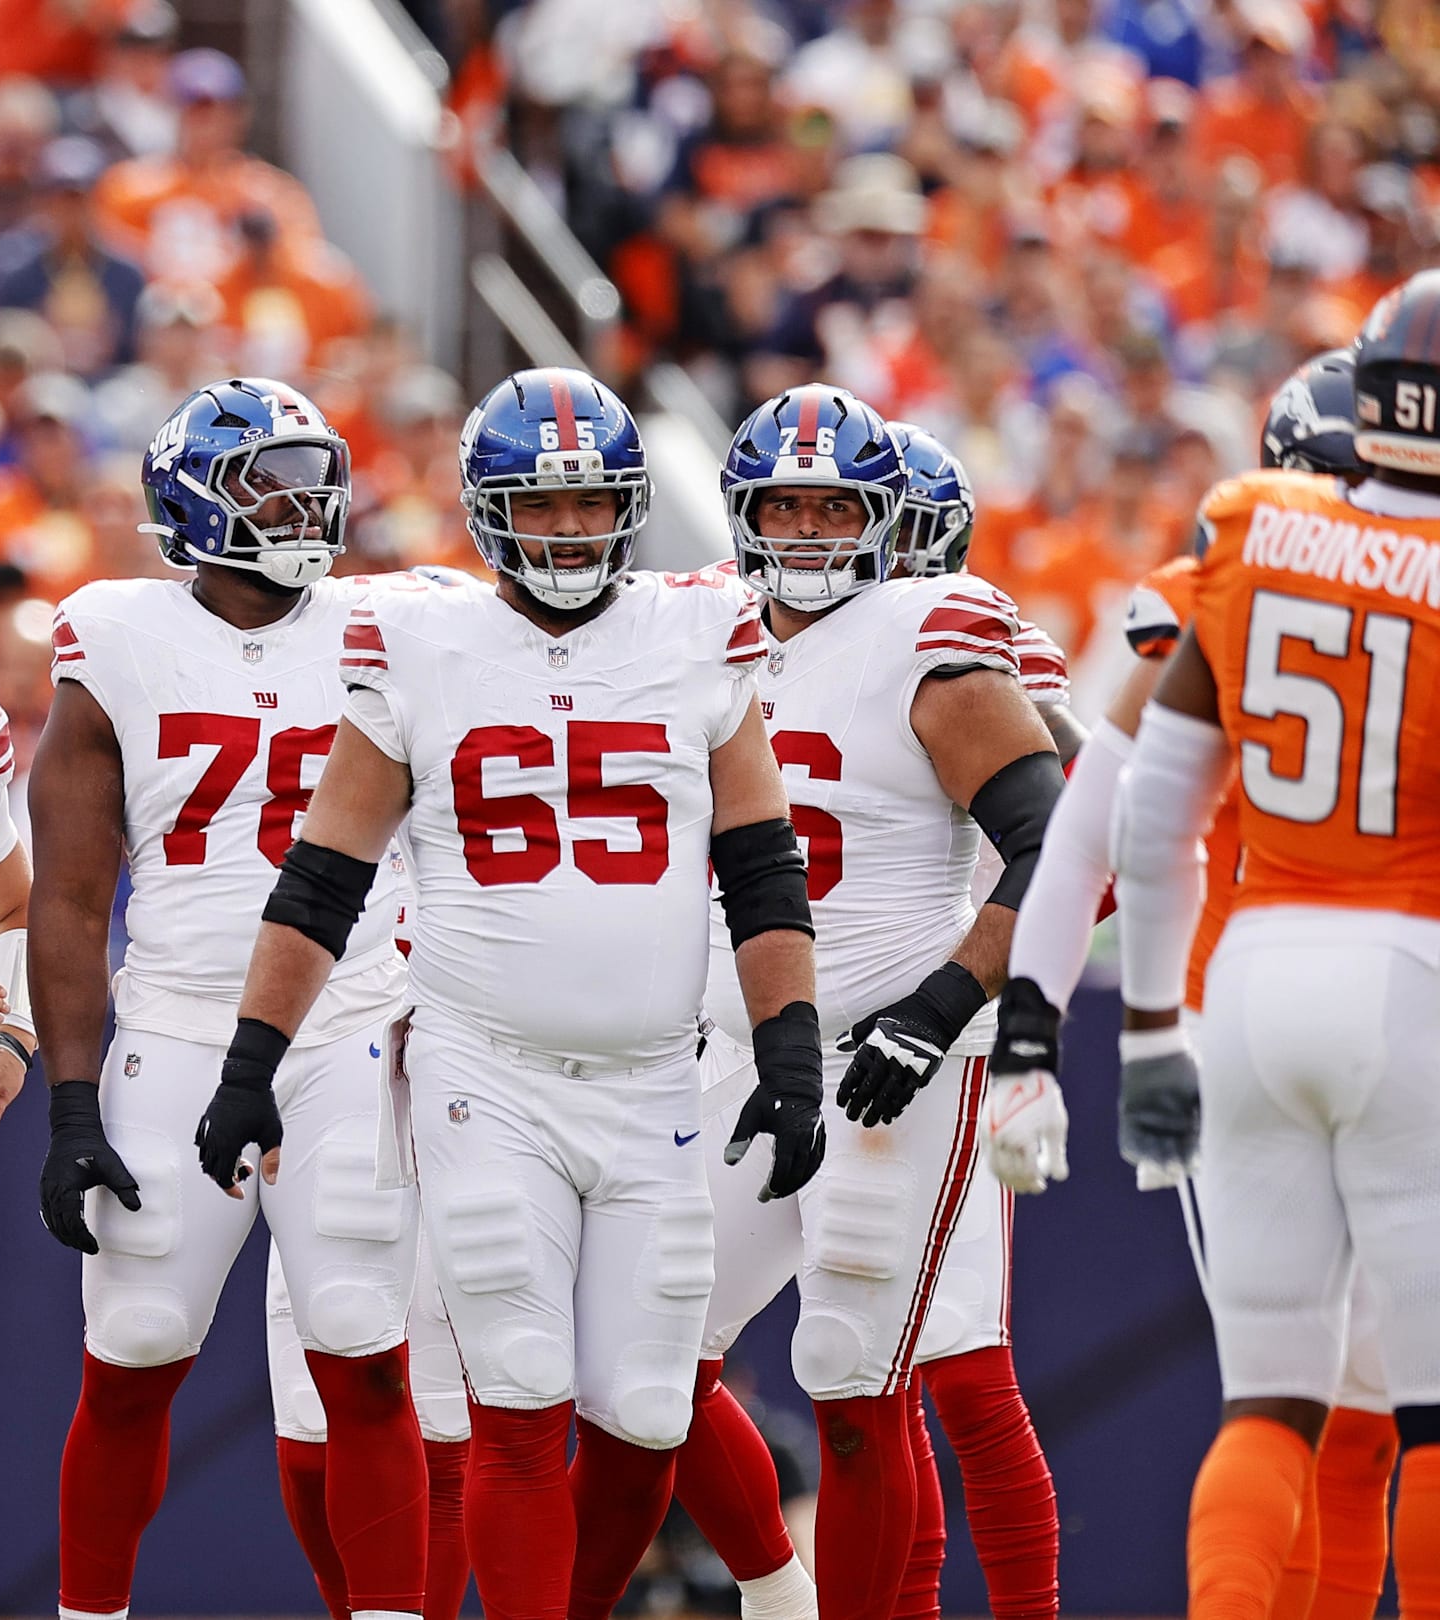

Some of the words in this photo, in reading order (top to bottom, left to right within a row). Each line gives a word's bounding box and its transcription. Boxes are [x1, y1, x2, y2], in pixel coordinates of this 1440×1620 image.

[1395, 380, 1437, 433] 51
[539, 421, 596, 450] 65
[779, 427, 836, 456] 76
[1242, 503, 1440, 610] ROBINSON
[252, 691, 278, 708] ny
[549, 694, 573, 711] ny
[1240, 587, 1414, 838] 51
[451, 720, 671, 887] 65
[768, 730, 843, 901] 6
